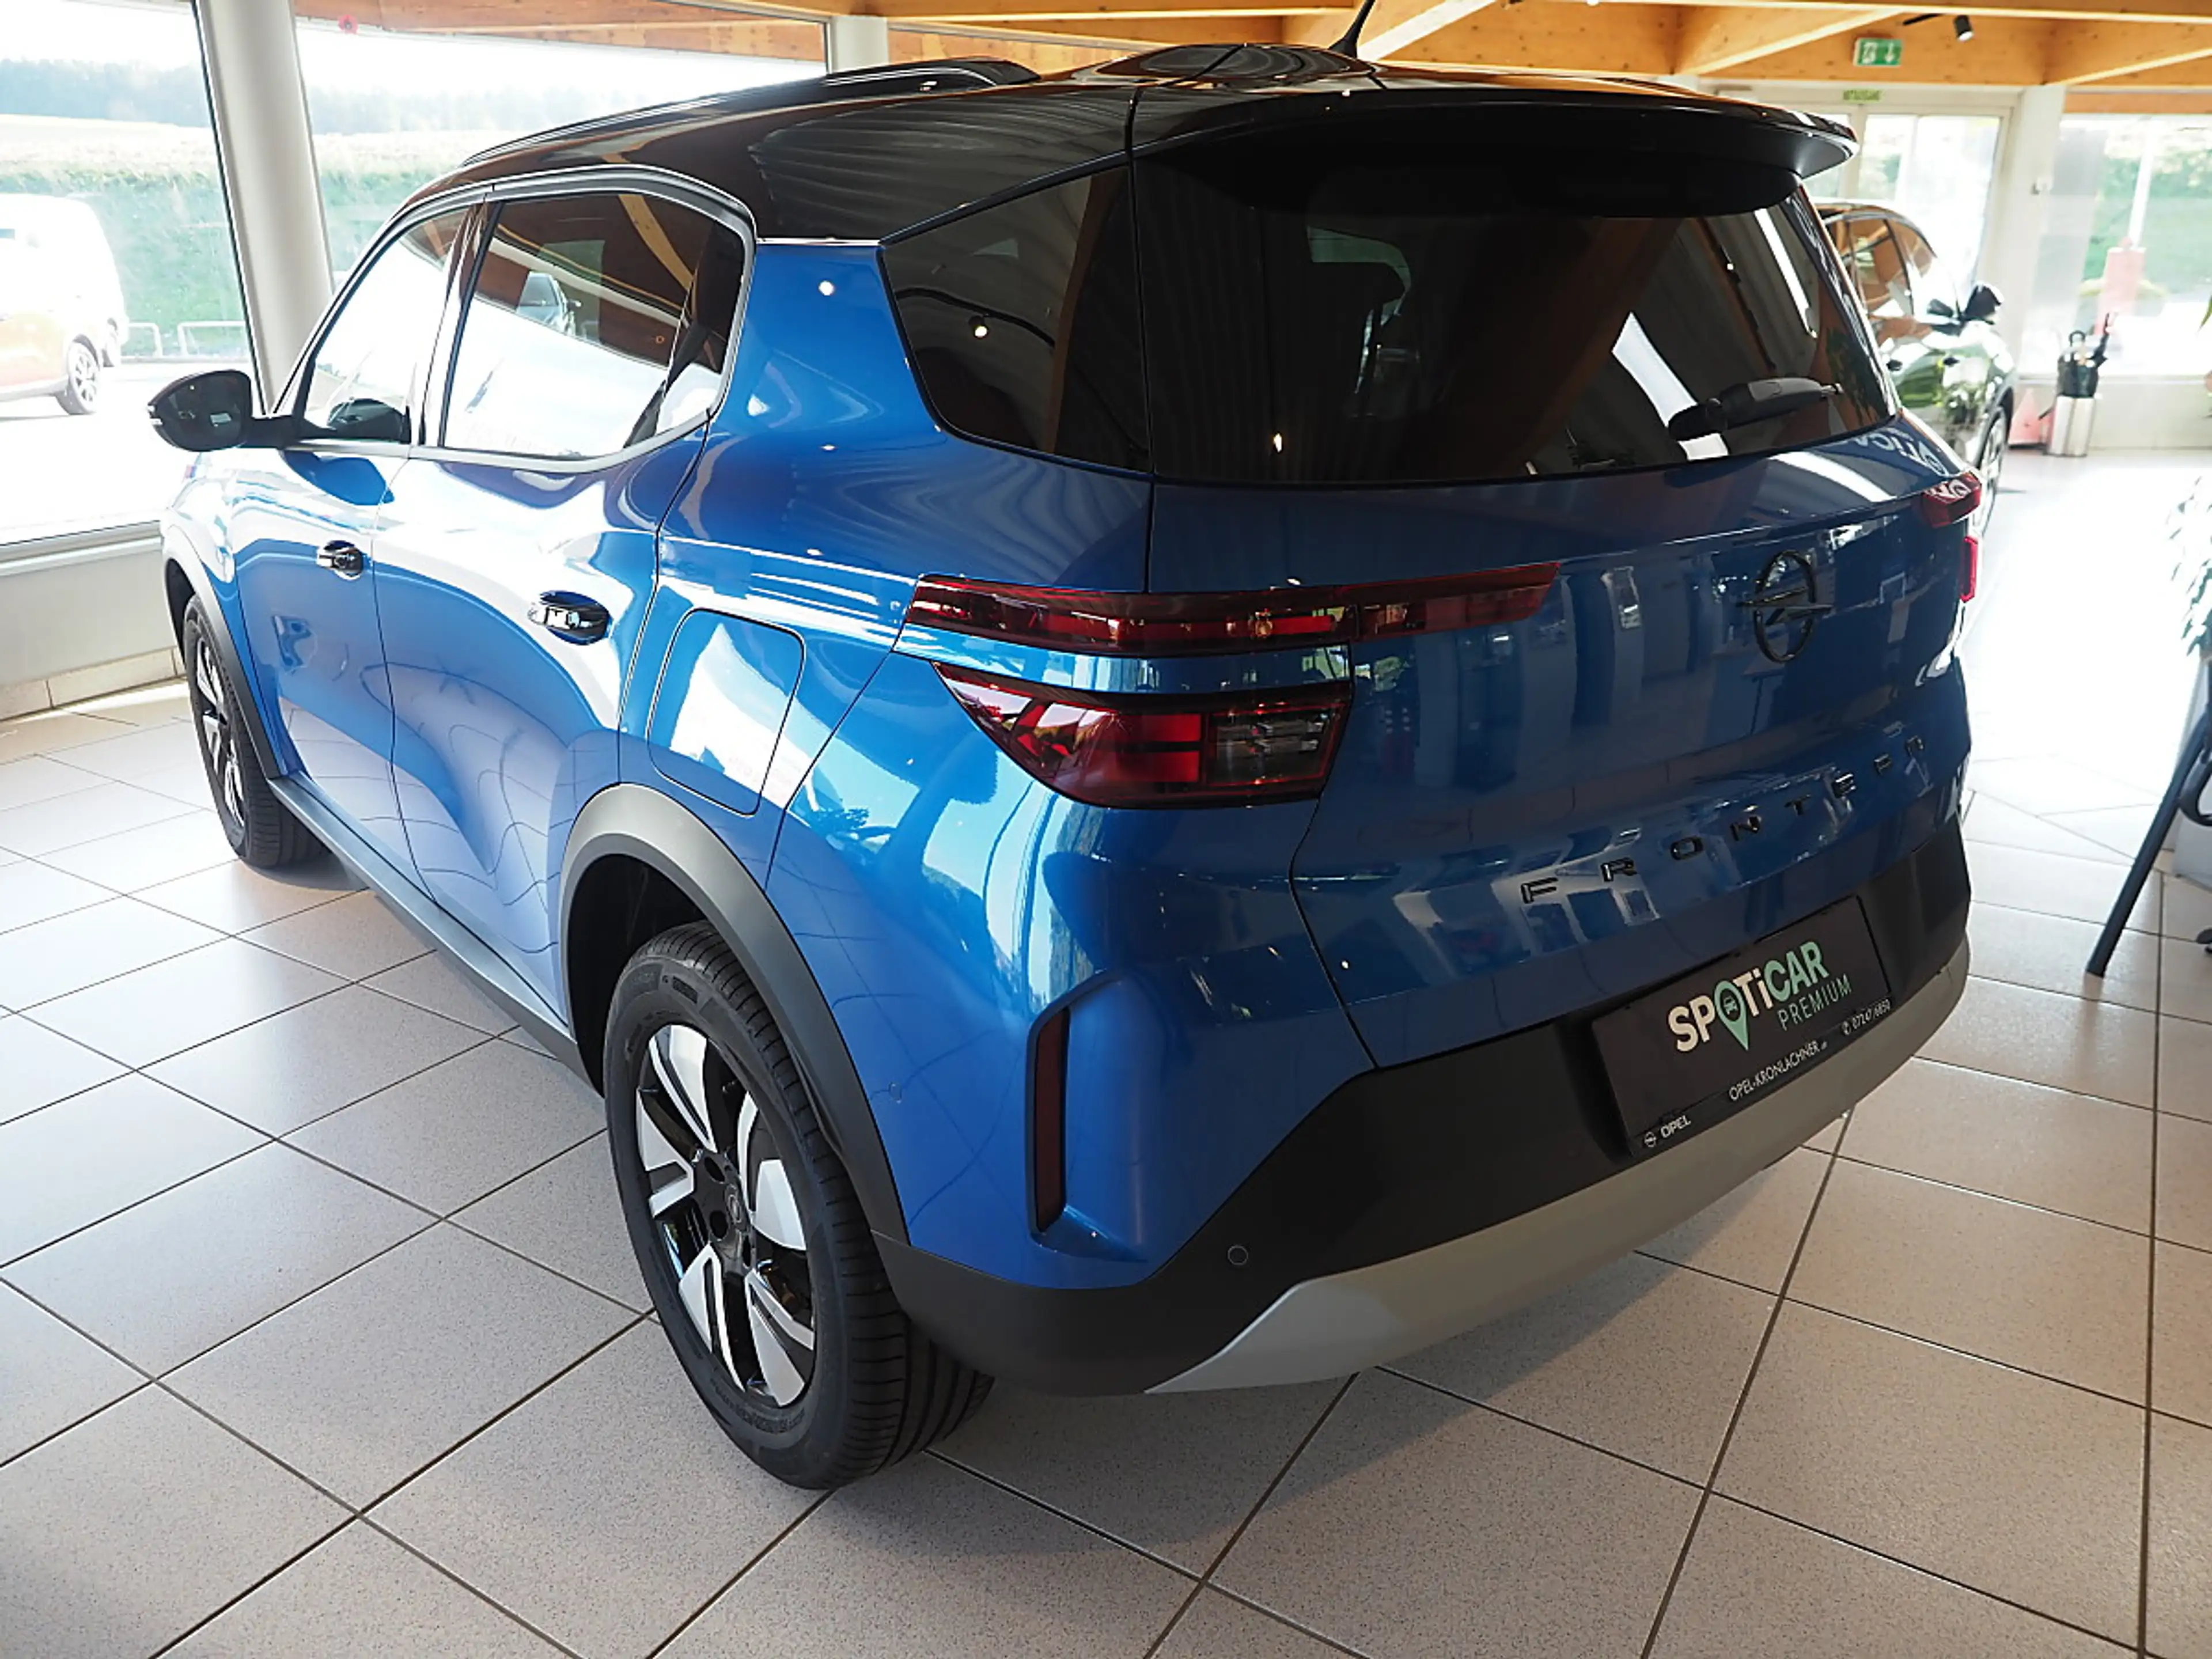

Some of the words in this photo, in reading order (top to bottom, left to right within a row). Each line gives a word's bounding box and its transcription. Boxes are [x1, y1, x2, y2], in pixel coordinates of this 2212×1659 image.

[1520, 735, 1925, 904] FRONTERA
[1778, 974, 1853, 1032] PREMIUM
[1660, 1115, 1692, 1138] OPEL
